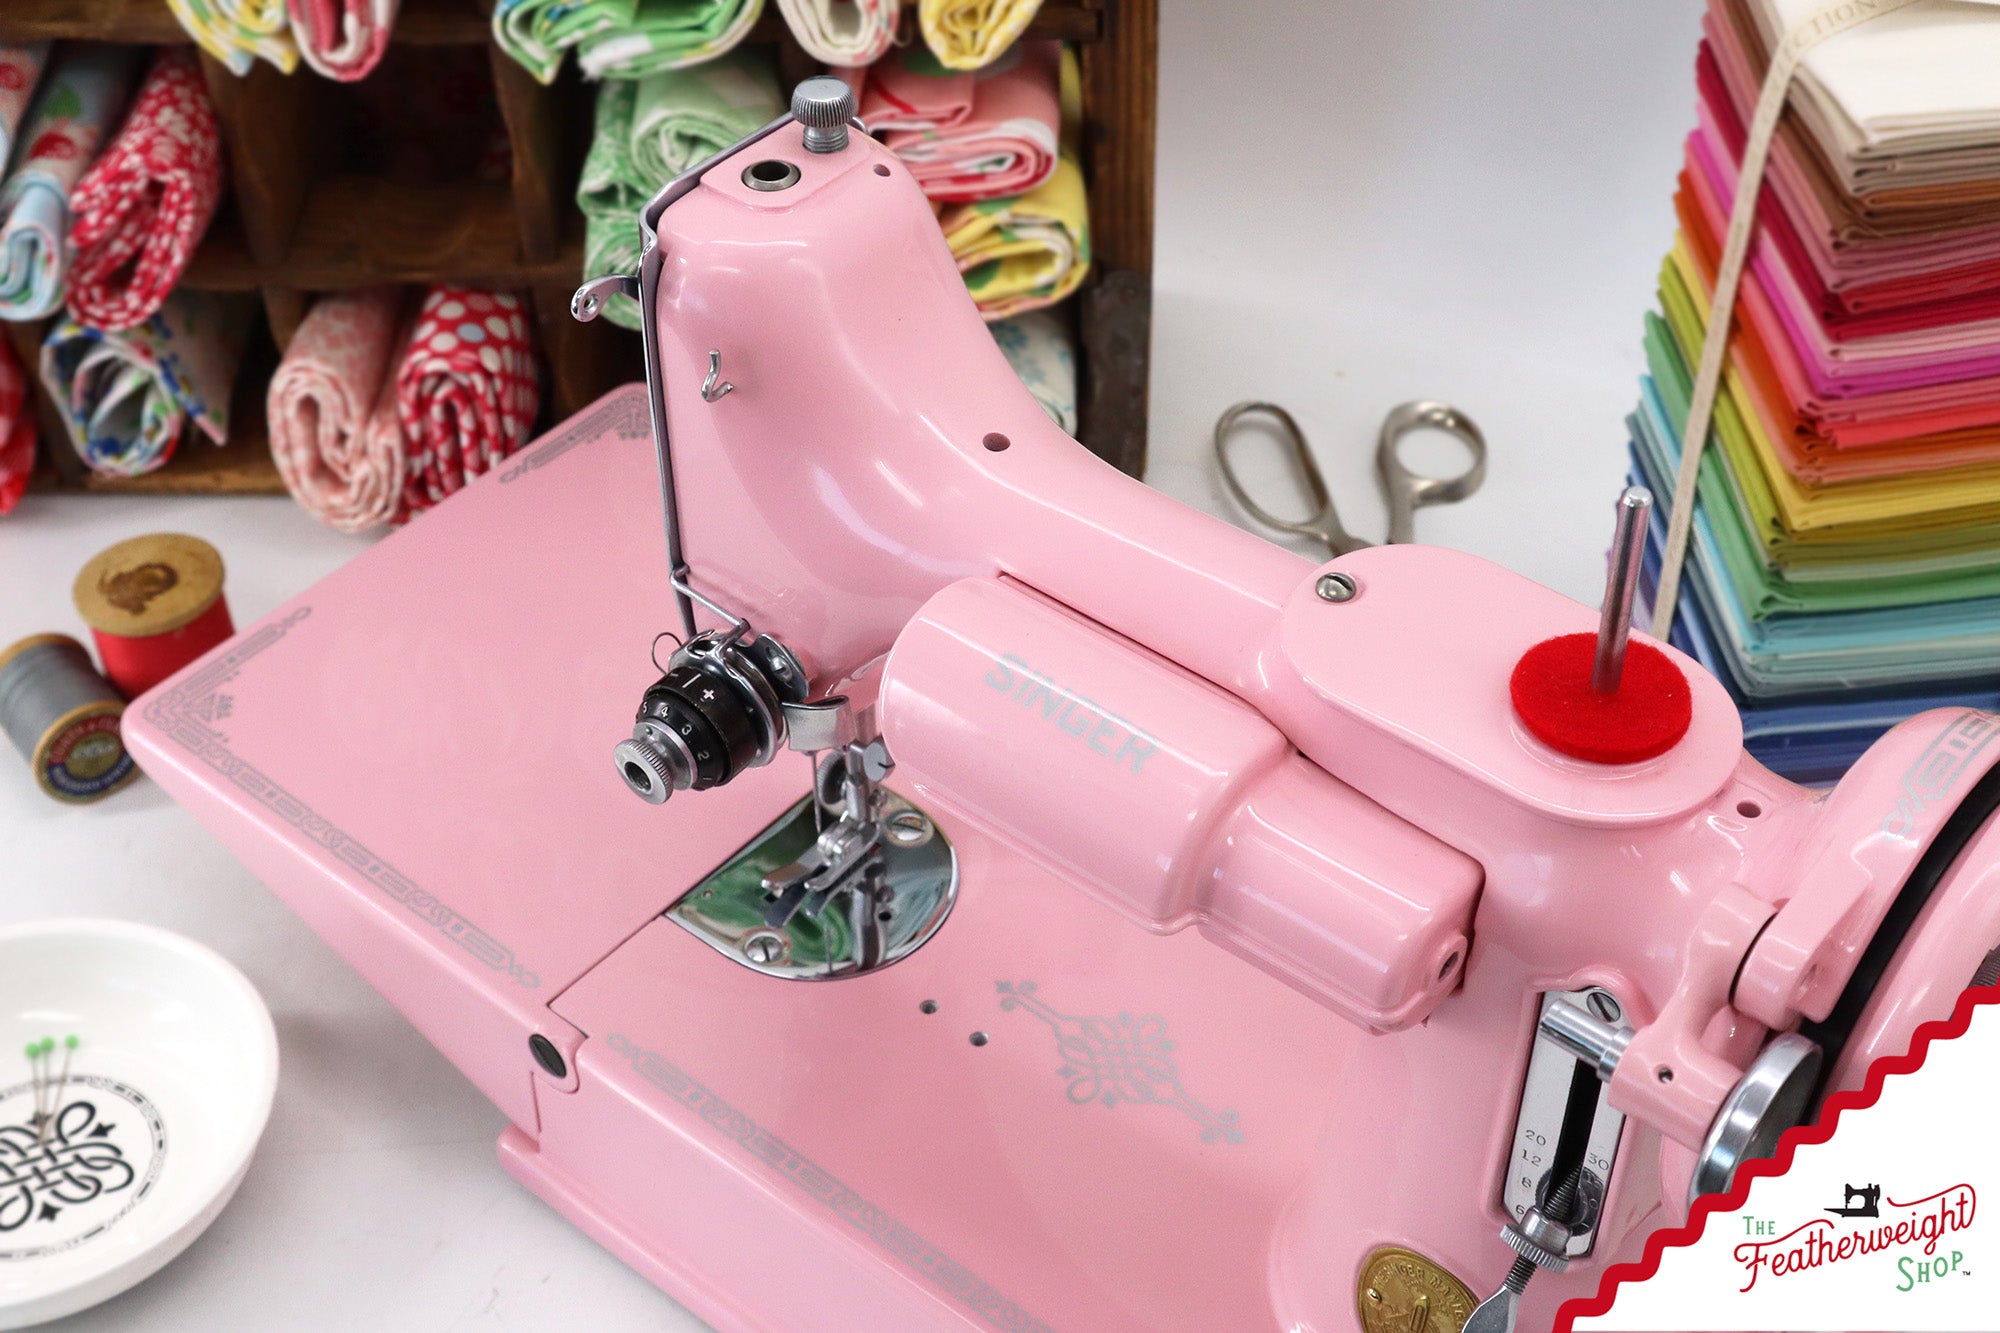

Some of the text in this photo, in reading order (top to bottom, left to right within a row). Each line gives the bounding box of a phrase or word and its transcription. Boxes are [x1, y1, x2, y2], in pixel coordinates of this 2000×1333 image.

[985, 653, 1159, 775] SINGER
[661, 707, 668, 718] 4
[681, 725, 692, 736] 3
[697, 751, 709, 761] 2
[1525, 1129, 1546, 1146] 20
[1522, 1148, 1541, 1167] 12
[1588, 1152, 1610, 1171] 30
[1516, 1205, 1525, 1215] 6
